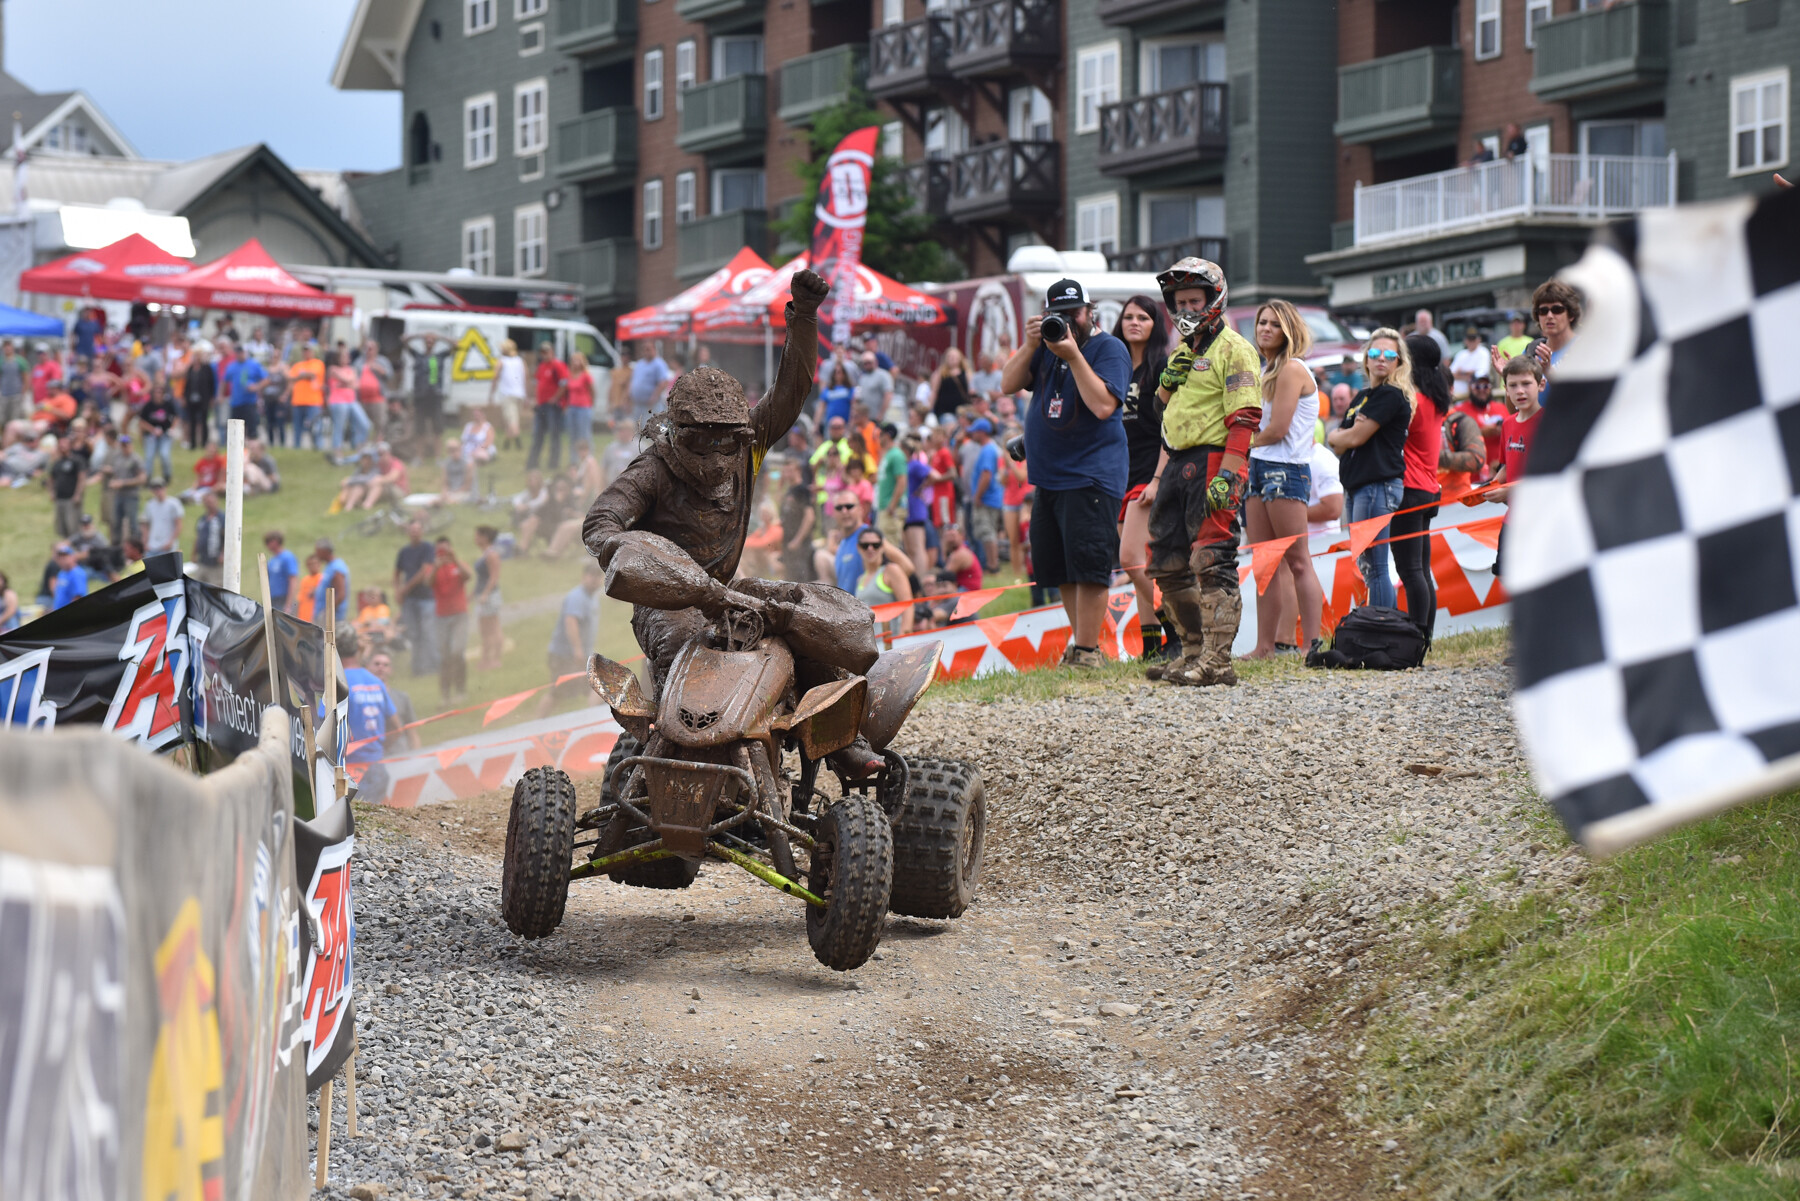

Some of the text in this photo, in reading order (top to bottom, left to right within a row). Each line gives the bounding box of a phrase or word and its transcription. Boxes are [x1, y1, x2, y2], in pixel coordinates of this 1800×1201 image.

[1373, 257, 1484, 295] HIGHLAND HOUSE
[212, 672, 259, 738] Protect
